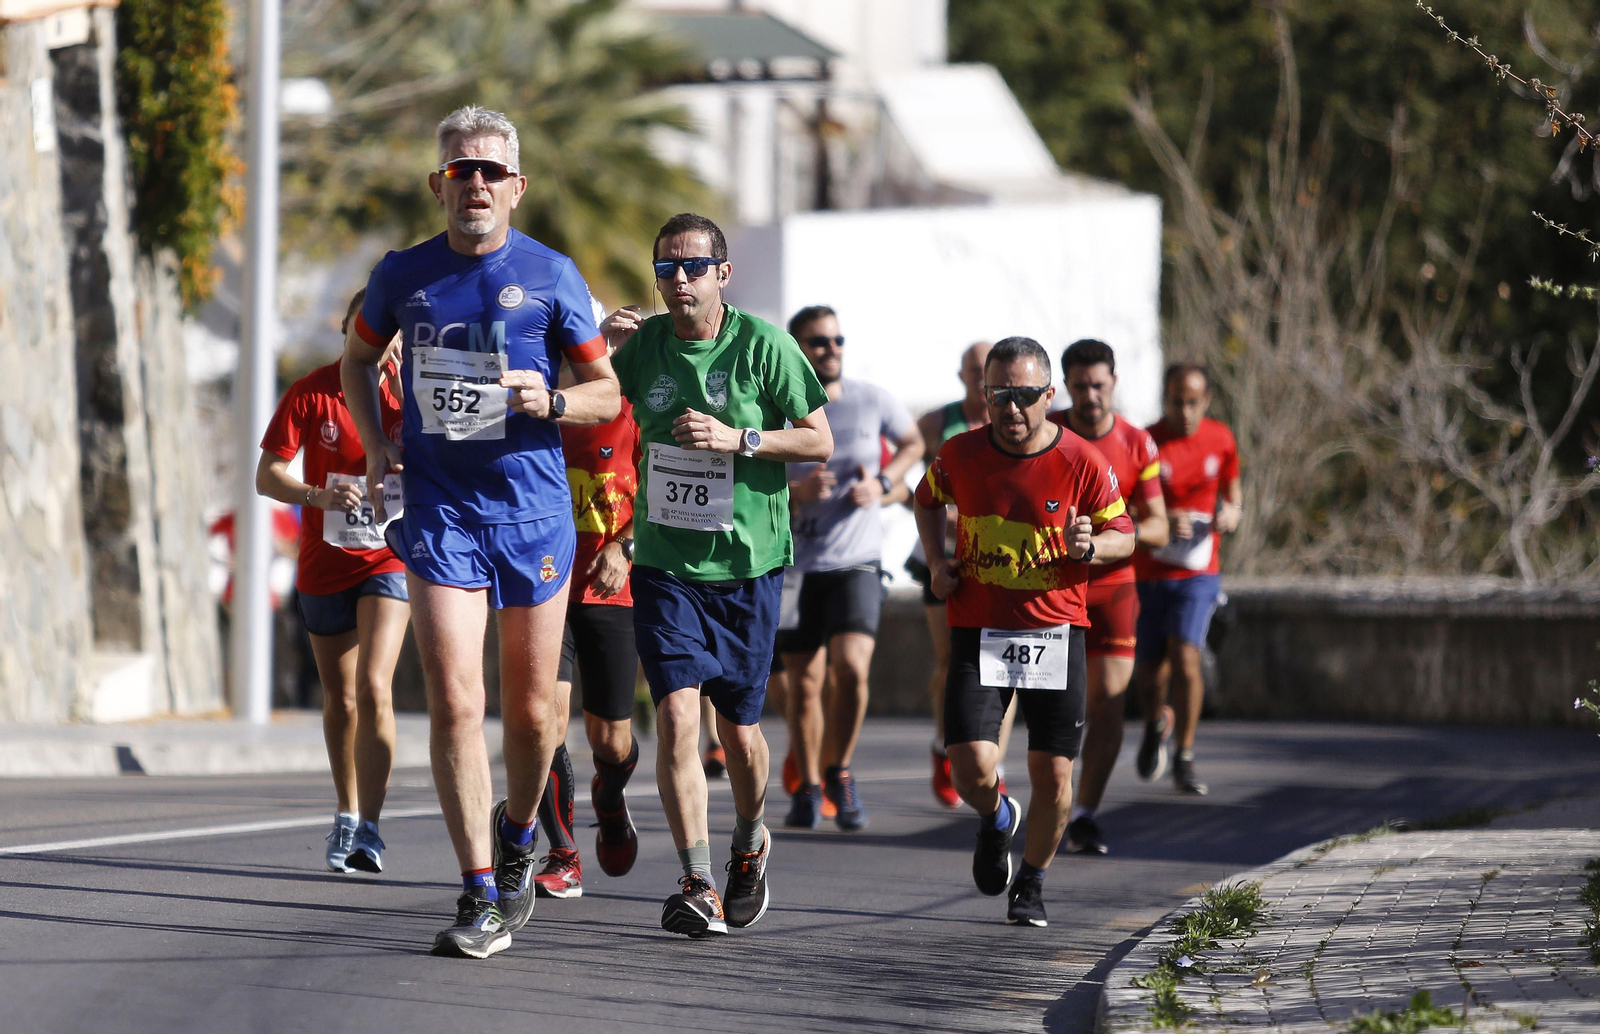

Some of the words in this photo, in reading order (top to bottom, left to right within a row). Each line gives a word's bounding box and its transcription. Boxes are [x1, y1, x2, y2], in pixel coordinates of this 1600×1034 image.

[413, 320, 506, 354] RCM
[432, 387, 481, 414] 552
[665, 480, 709, 506] 378
[345, 507, 385, 527] 65
[1001, 643, 1047, 665] 487
